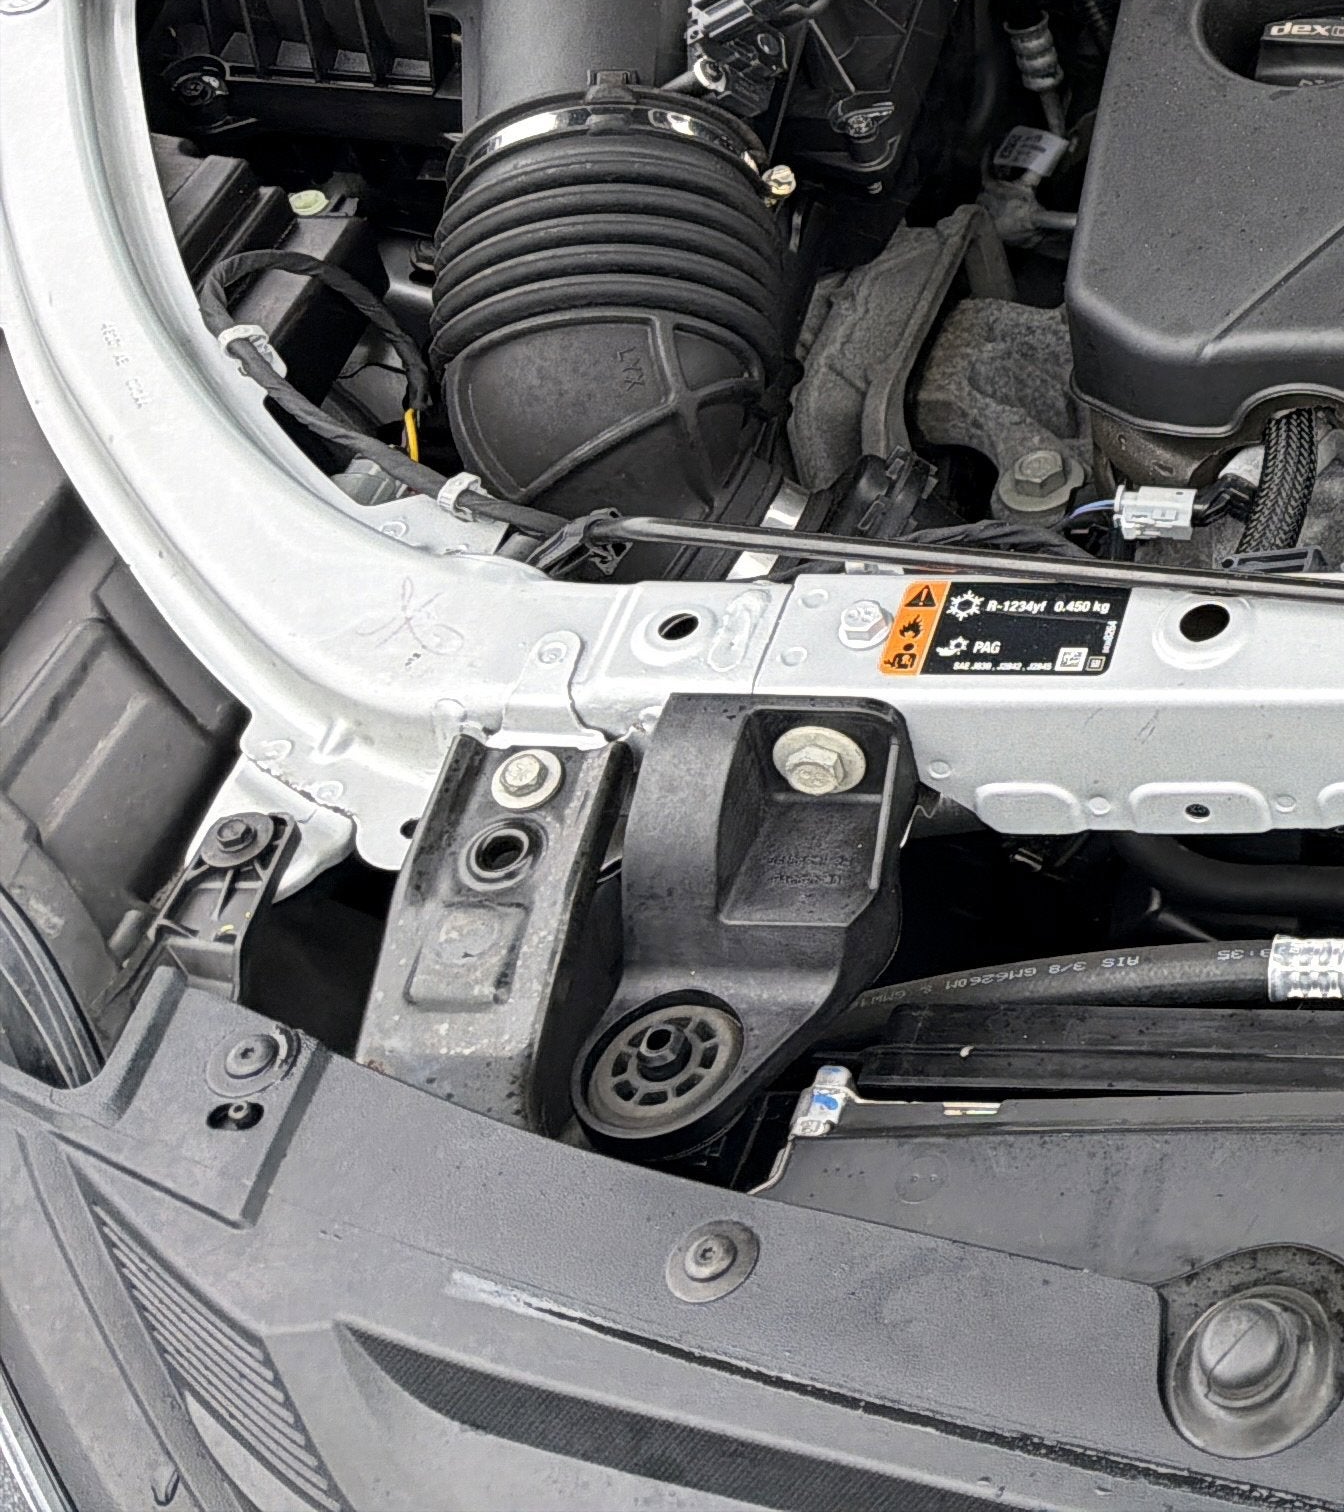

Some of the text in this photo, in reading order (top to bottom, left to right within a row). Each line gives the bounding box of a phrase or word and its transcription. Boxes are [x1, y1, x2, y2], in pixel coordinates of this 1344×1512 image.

[985, 600, 1111, 615] R-1234yf 0.450 kg
[972, 640, 1002, 654] PAG
[1048, 960, 1087, 975] 3/8
